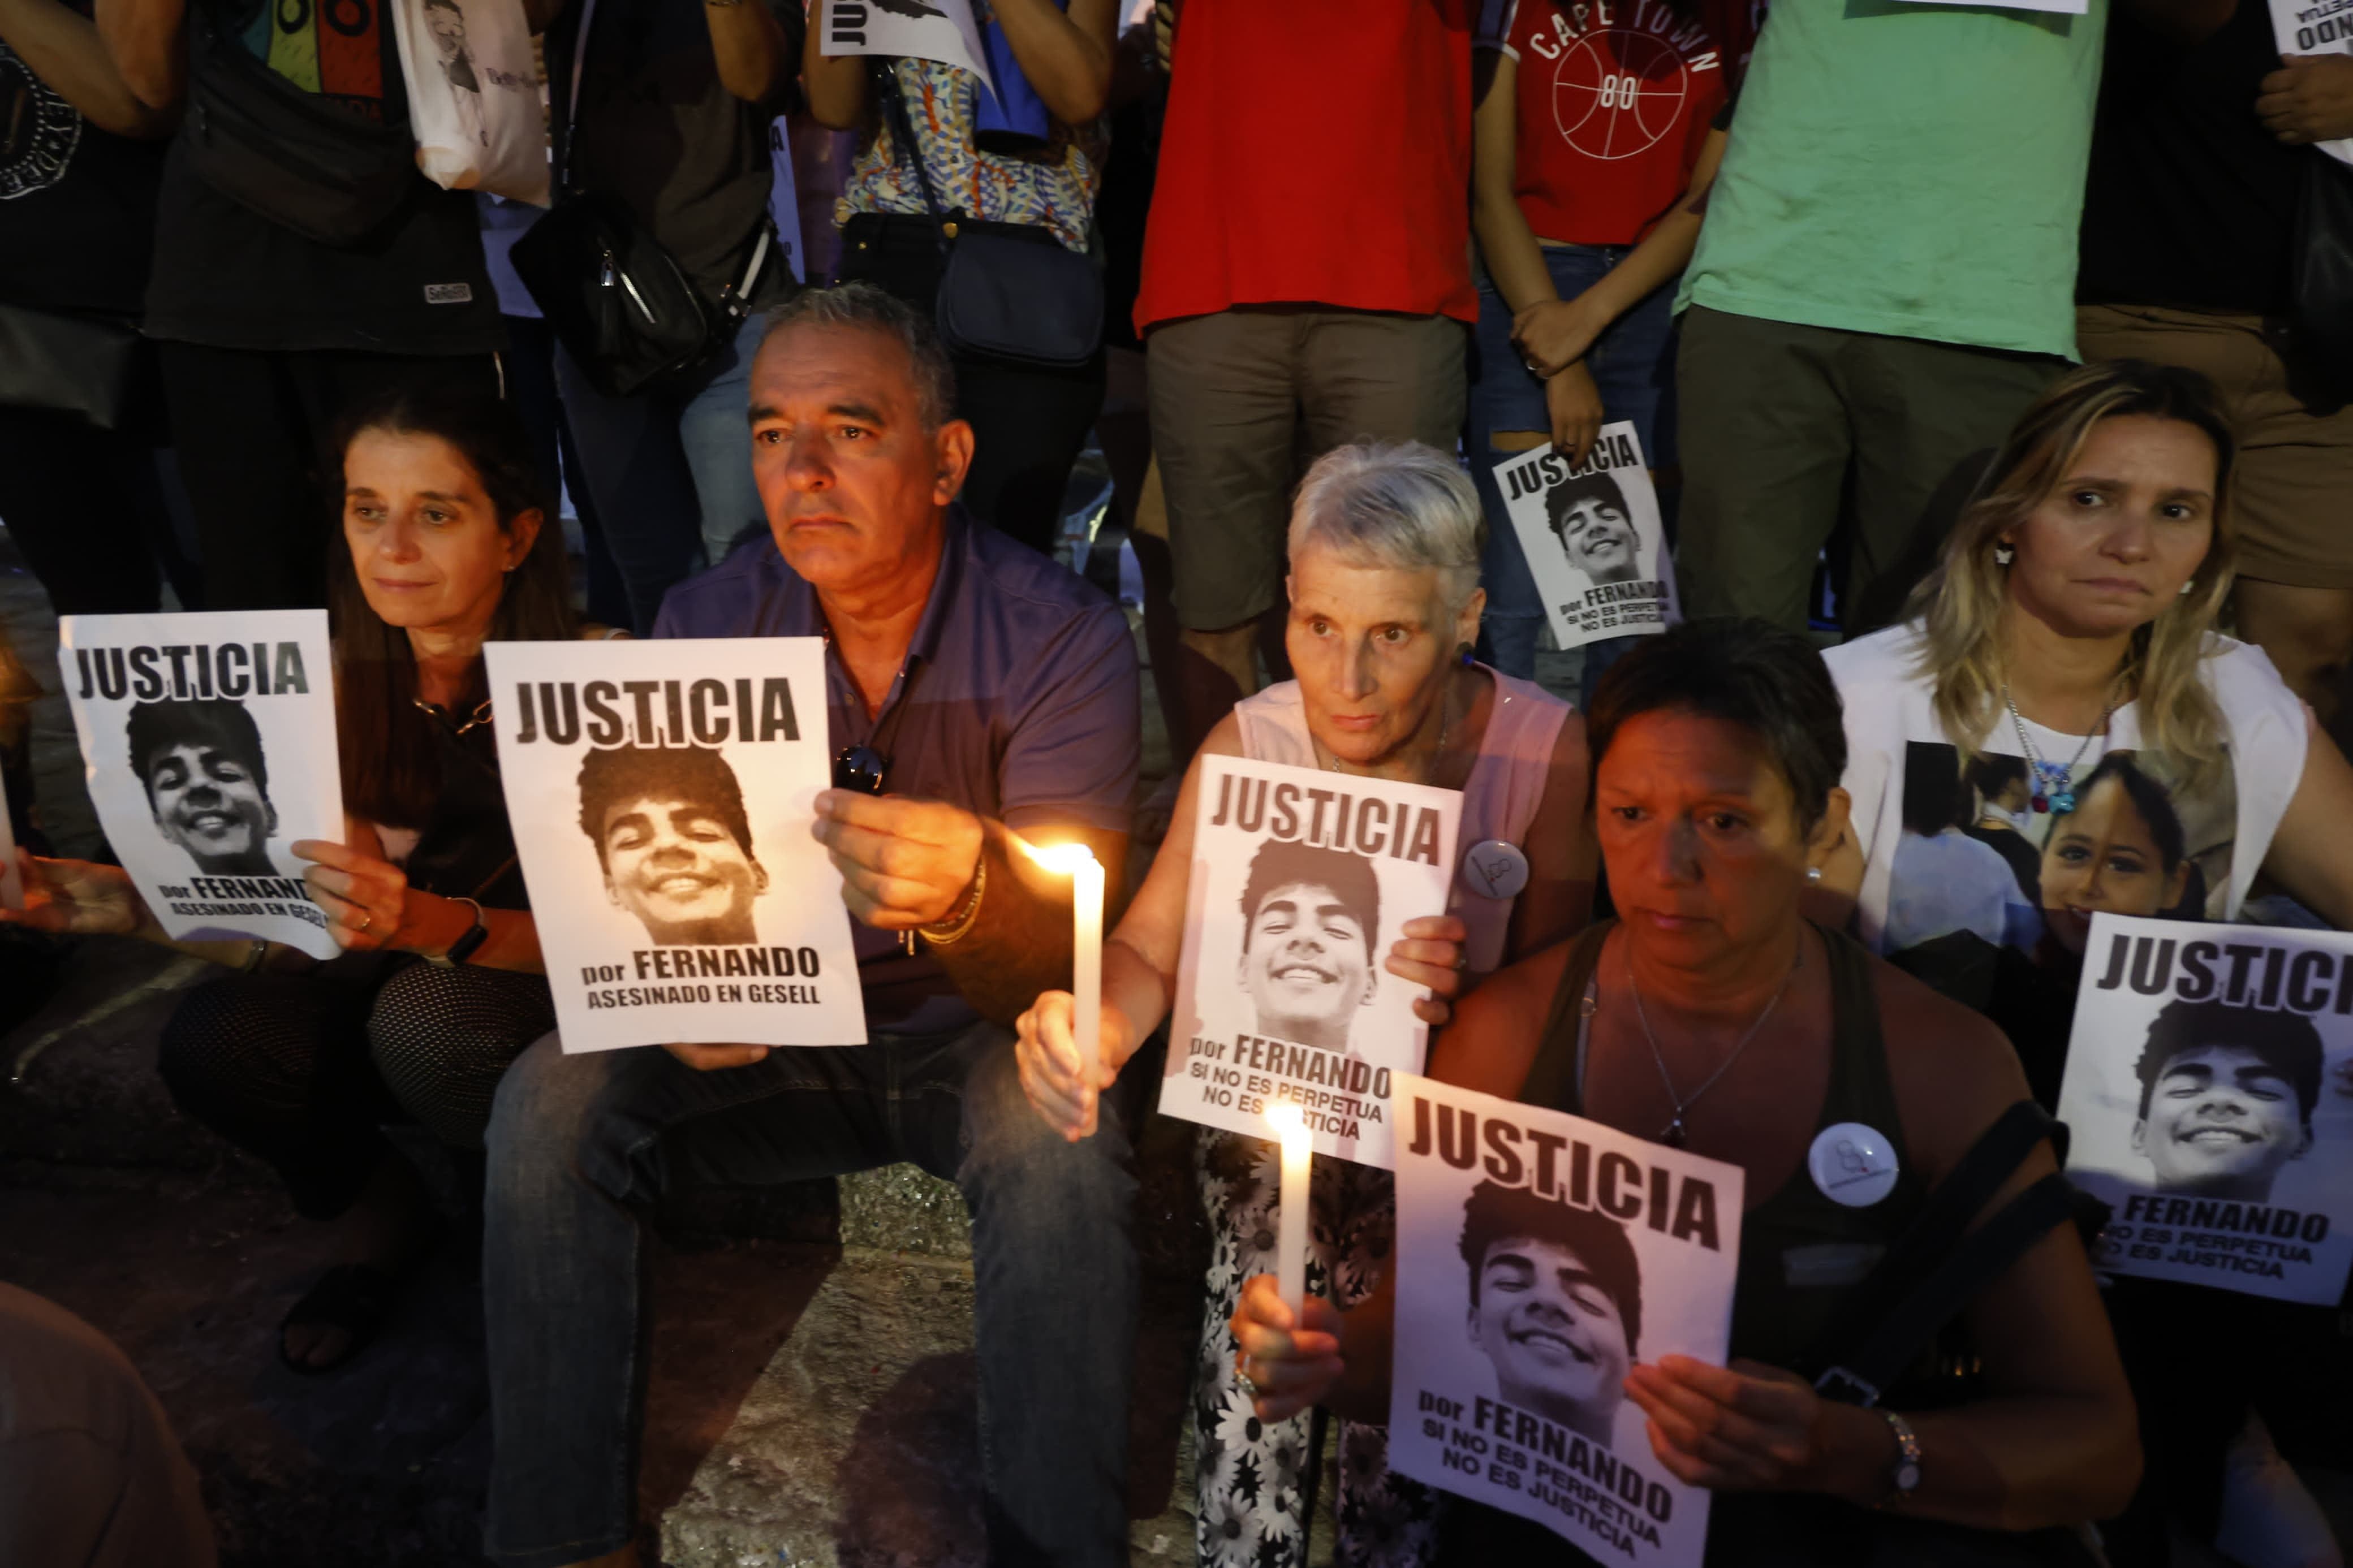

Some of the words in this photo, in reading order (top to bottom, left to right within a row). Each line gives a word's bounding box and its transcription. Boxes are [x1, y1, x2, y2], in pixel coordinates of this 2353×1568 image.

[1529, 0, 1614, 59] CAPE
[1634, 0, 1721, 73] TOWN
[1600, 74, 1637, 110] 80
[1506, 434, 1639, 500] JUSCIA
[1581, 609, 1599, 621] NO
[1601, 606, 1617, 616] ES
[1584, 580, 1669, 607] FERNANDO
[1581, 620, 1600, 632] NO
[1602, 616, 1618, 628] ES
[76, 641, 310, 701] JUSTICIA
[516, 677, 801, 745] JUSTICIA
[1212, 774, 1441, 867] JUSTICIA
[581, 963, 625, 986] por
[634, 946, 820, 980] FERNANDO
[588, 984, 712, 1009] ASESINADO
[718, 984, 742, 1004] EN
[749, 984, 821, 1005] GESELL
[1190, 1035, 1226, 1060] por
[1234, 1033, 1391, 1100] FERNANDO
[1191, 1061, 1209, 1080] SI
[1213, 1066, 1240, 1087] NO
[1247, 1074, 1272, 1095] ES
[1277, 1082, 1383, 1124] PERPETUA
[1203, 1085, 1232, 1107] NO
[1238, 1094, 1264, 1115] ES
[1409, 1096, 1720, 1252] JUSTICIA
[2124, 1195, 2330, 1243] FERNANDO
[2140, 1227, 2173, 1244] ES
[2179, 1231, 2313, 1264] PERPETUA
[2130, 1243, 2162, 1260] ES
[2167, 1249, 2284, 1280] JUSTICIA
[1418, 1389, 1464, 1422] por
[1475, 1396, 1673, 1524] FERNANDO
[1422, 1419, 1445, 1442] SI
[1451, 1427, 1486, 1455] NO
[1497, 1441, 1527, 1471] ES
[1535, 1454, 1662, 1549] PERPETUA
[1442, 1446, 1480, 1477] NO
[1488, 1463, 1521, 1491] ES
[1527, 1477, 1636, 1560] JUSTICIA
